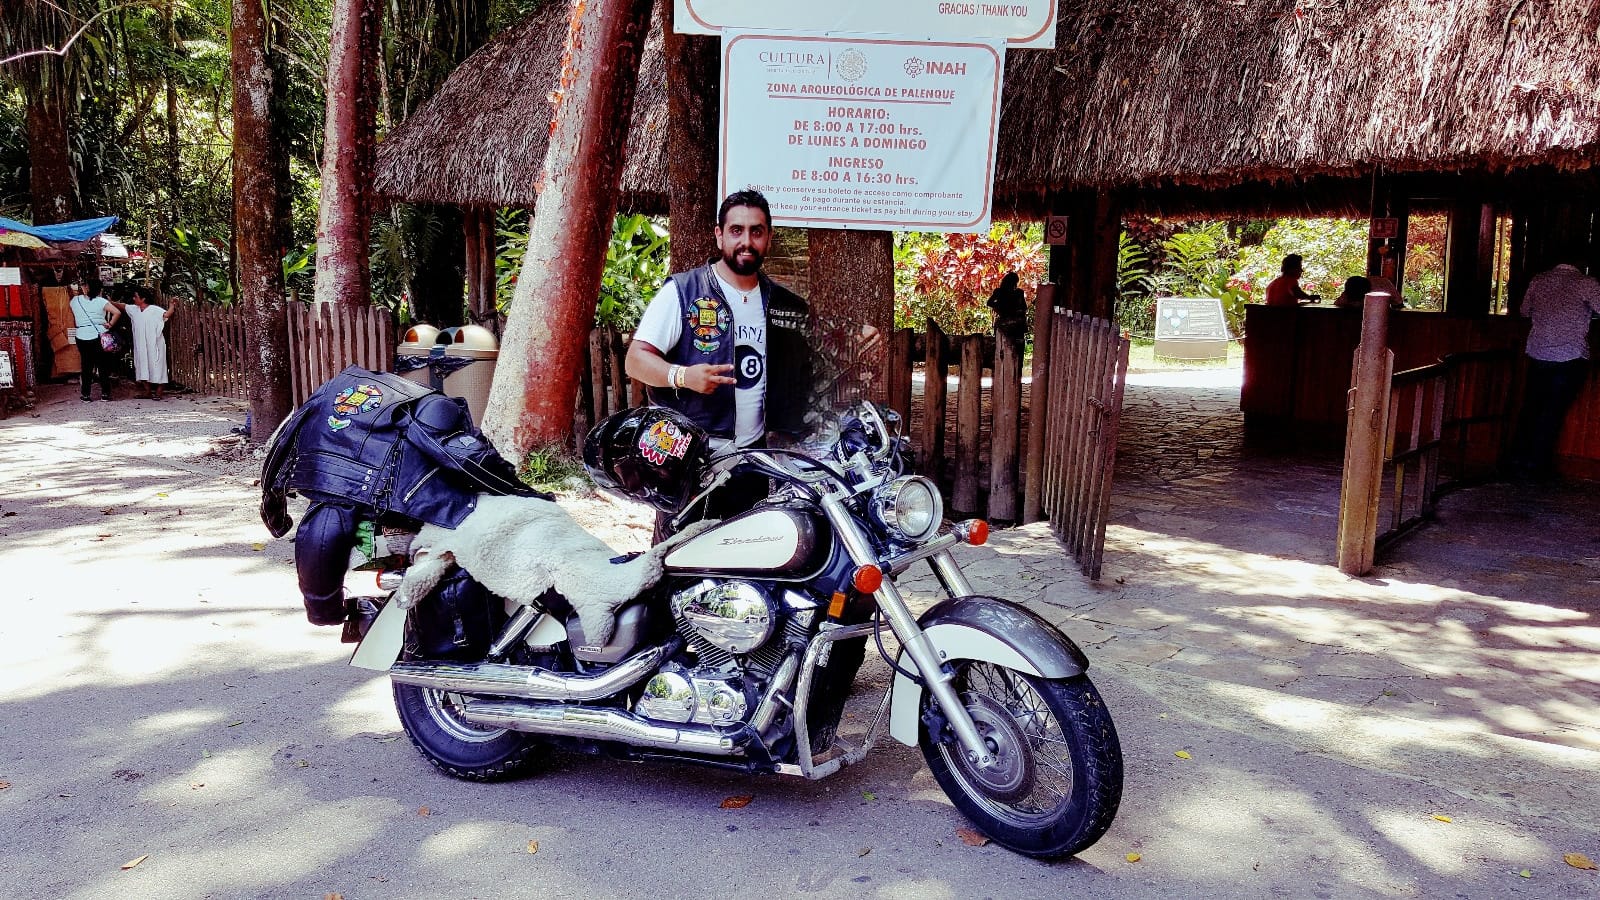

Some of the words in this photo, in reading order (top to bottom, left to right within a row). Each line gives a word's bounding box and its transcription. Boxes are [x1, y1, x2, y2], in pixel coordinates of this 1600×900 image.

[939, 3, 974, 15] GRACIAS
[976, 4, 980, 15] /
[982, 4, 1008, 16] THANK
[1011, 6, 1027, 17] YOU
[759, 52, 824, 64] CULTURA
[926, 62, 966, 75] INAH
[767, 83, 796, 93] ZONA
[801, 84, 880, 96] ARQUEOLÓGICA
[884, 87, 897, 97] DE
[902, 88, 955, 99] PALENQUE
[828, 107, 890, 119] HORARIO:
[794, 121, 809, 131] DE
[814, 121, 841, 132] 8:00
[846, 123, 854, 133] A
[860, 123, 894, 134] 17:00
[900, 124, 922, 135] hrs.
[788, 135, 803, 145] DE
[808, 136, 846, 147] LUNES
[851, 137, 858, 147] A
[864, 138, 926, 150] DOMINGO
[829, 157, 883, 169] INGRESO
[792, 170, 806, 180] DE
[811, 171, 838, 182] 8:00
[843, 172, 851, 182] A
[857, 172, 891, 184] 16:30
[896, 174, 918, 185] hrs.
[747, 184, 774, 192] Solicite
[913, 208, 936, 217] during
[958, 210, 974, 218] stay.
[746, 358, 756, 375] 8
